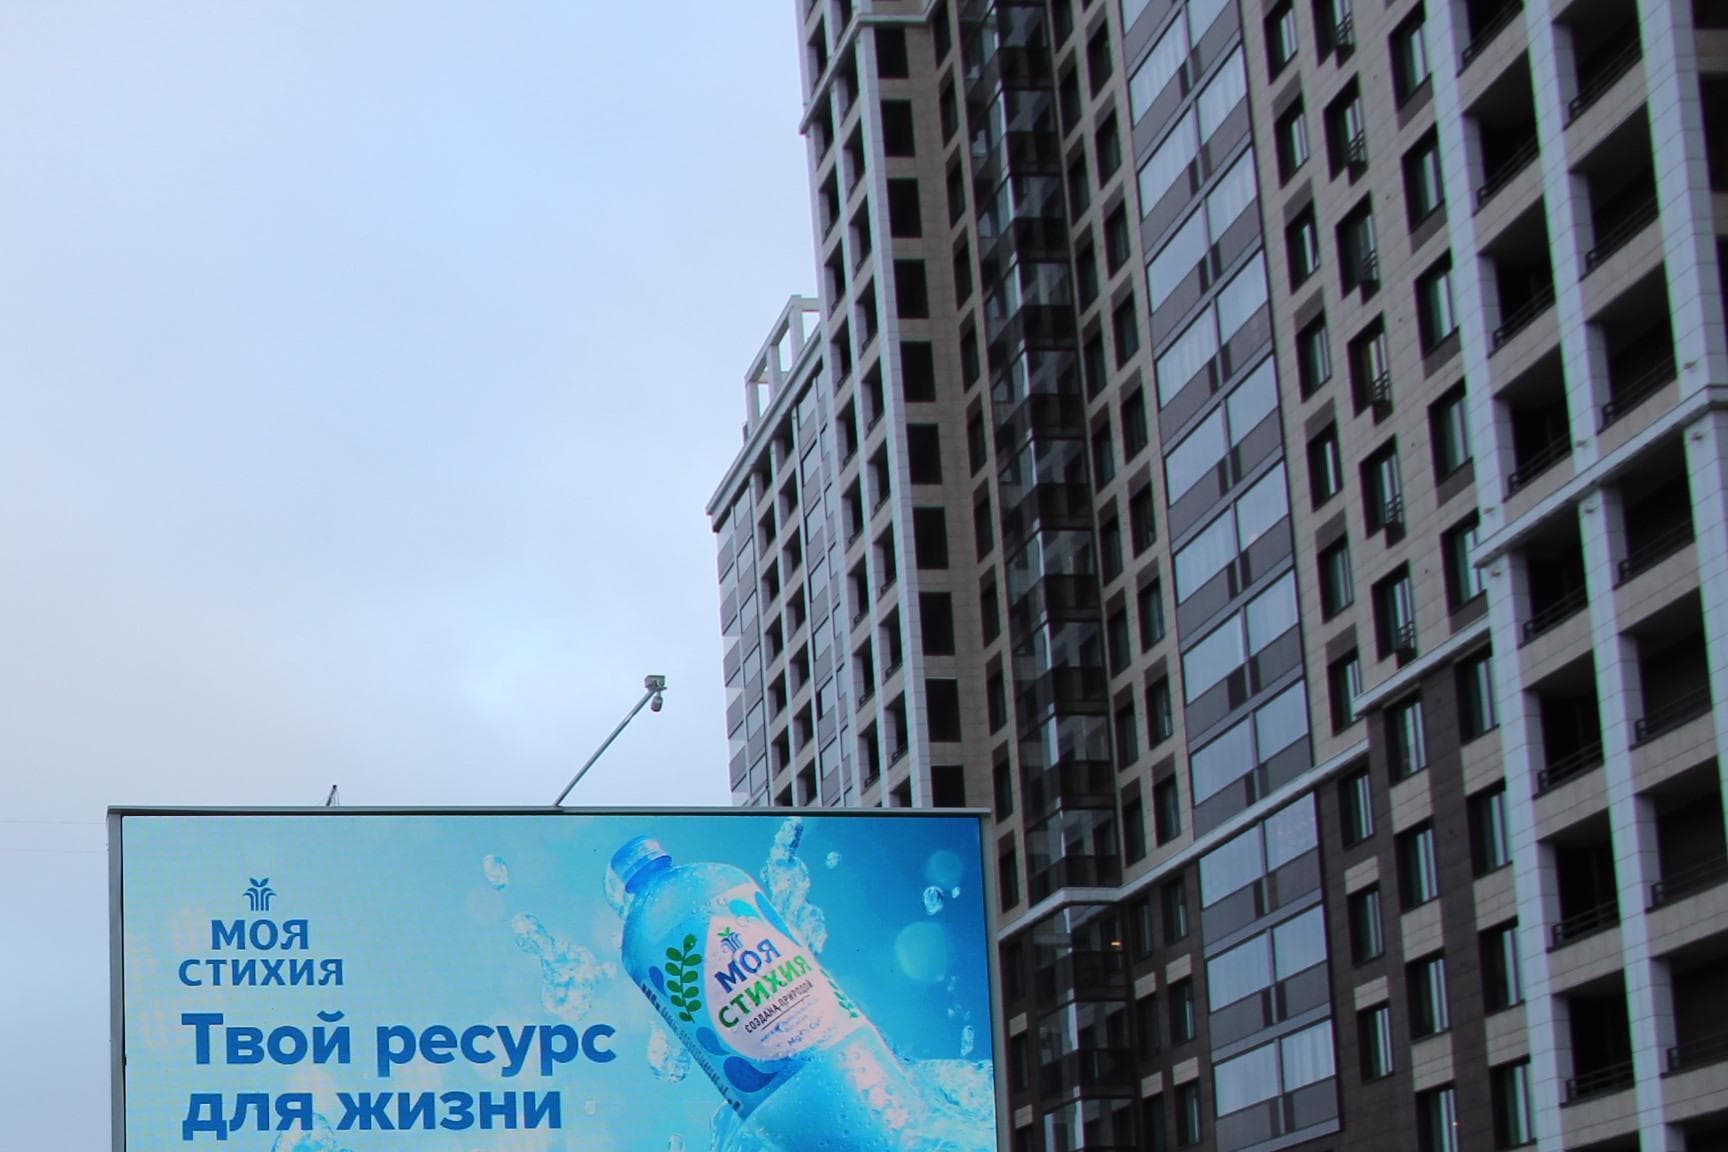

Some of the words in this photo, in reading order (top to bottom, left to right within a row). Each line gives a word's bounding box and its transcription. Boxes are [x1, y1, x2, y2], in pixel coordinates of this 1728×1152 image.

[211, 919, 309, 950] МОЯ
[178, 958, 343, 987] СТИХИЯ
[714, 938, 781, 993] МОЯ
[718, 955, 812, 1029] СТИХИЯ
[181, 1010, 351, 1064] Твой
[376, 1023, 616, 1077] ресурс
[182, 1092, 313, 1141] для
[336, 1091, 561, 1130] жизни
